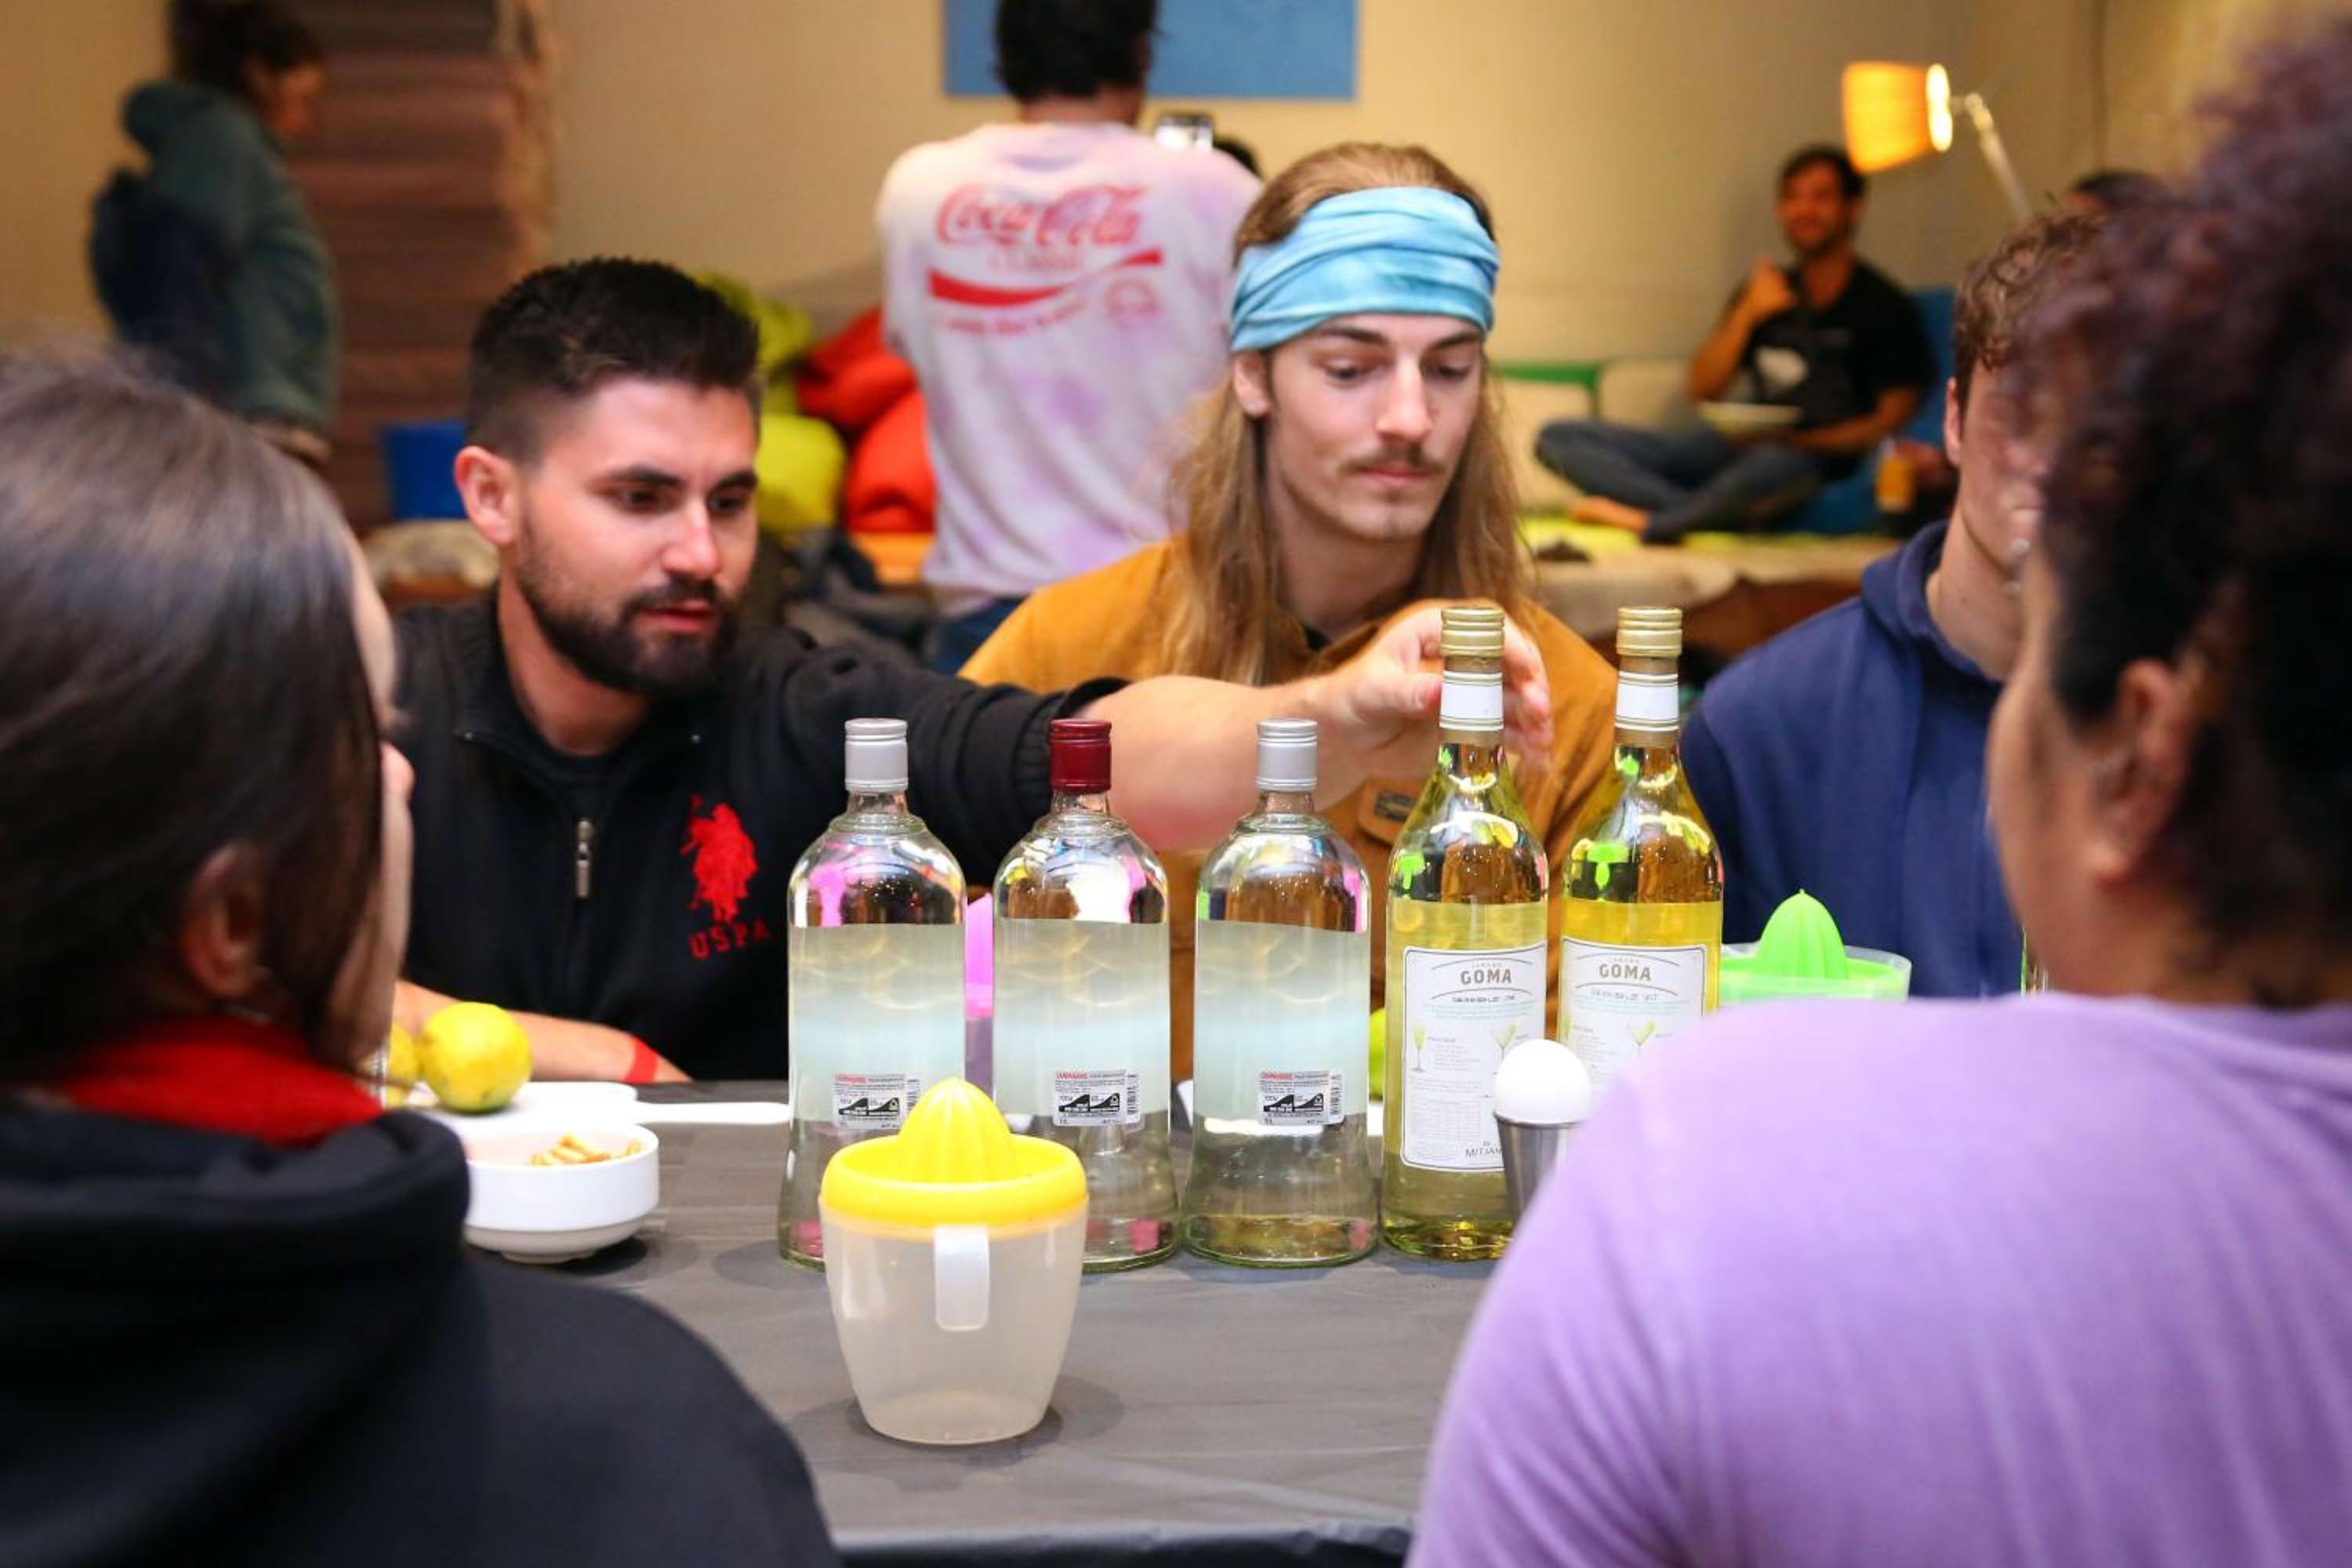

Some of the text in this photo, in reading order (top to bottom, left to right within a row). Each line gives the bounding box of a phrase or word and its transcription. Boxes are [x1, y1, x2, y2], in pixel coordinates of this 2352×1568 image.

[1461, 968, 1512, 985] GOMA
[1599, 964, 1651, 981] GOMA
[1465, 1147, 1502, 1158] MITJAN
